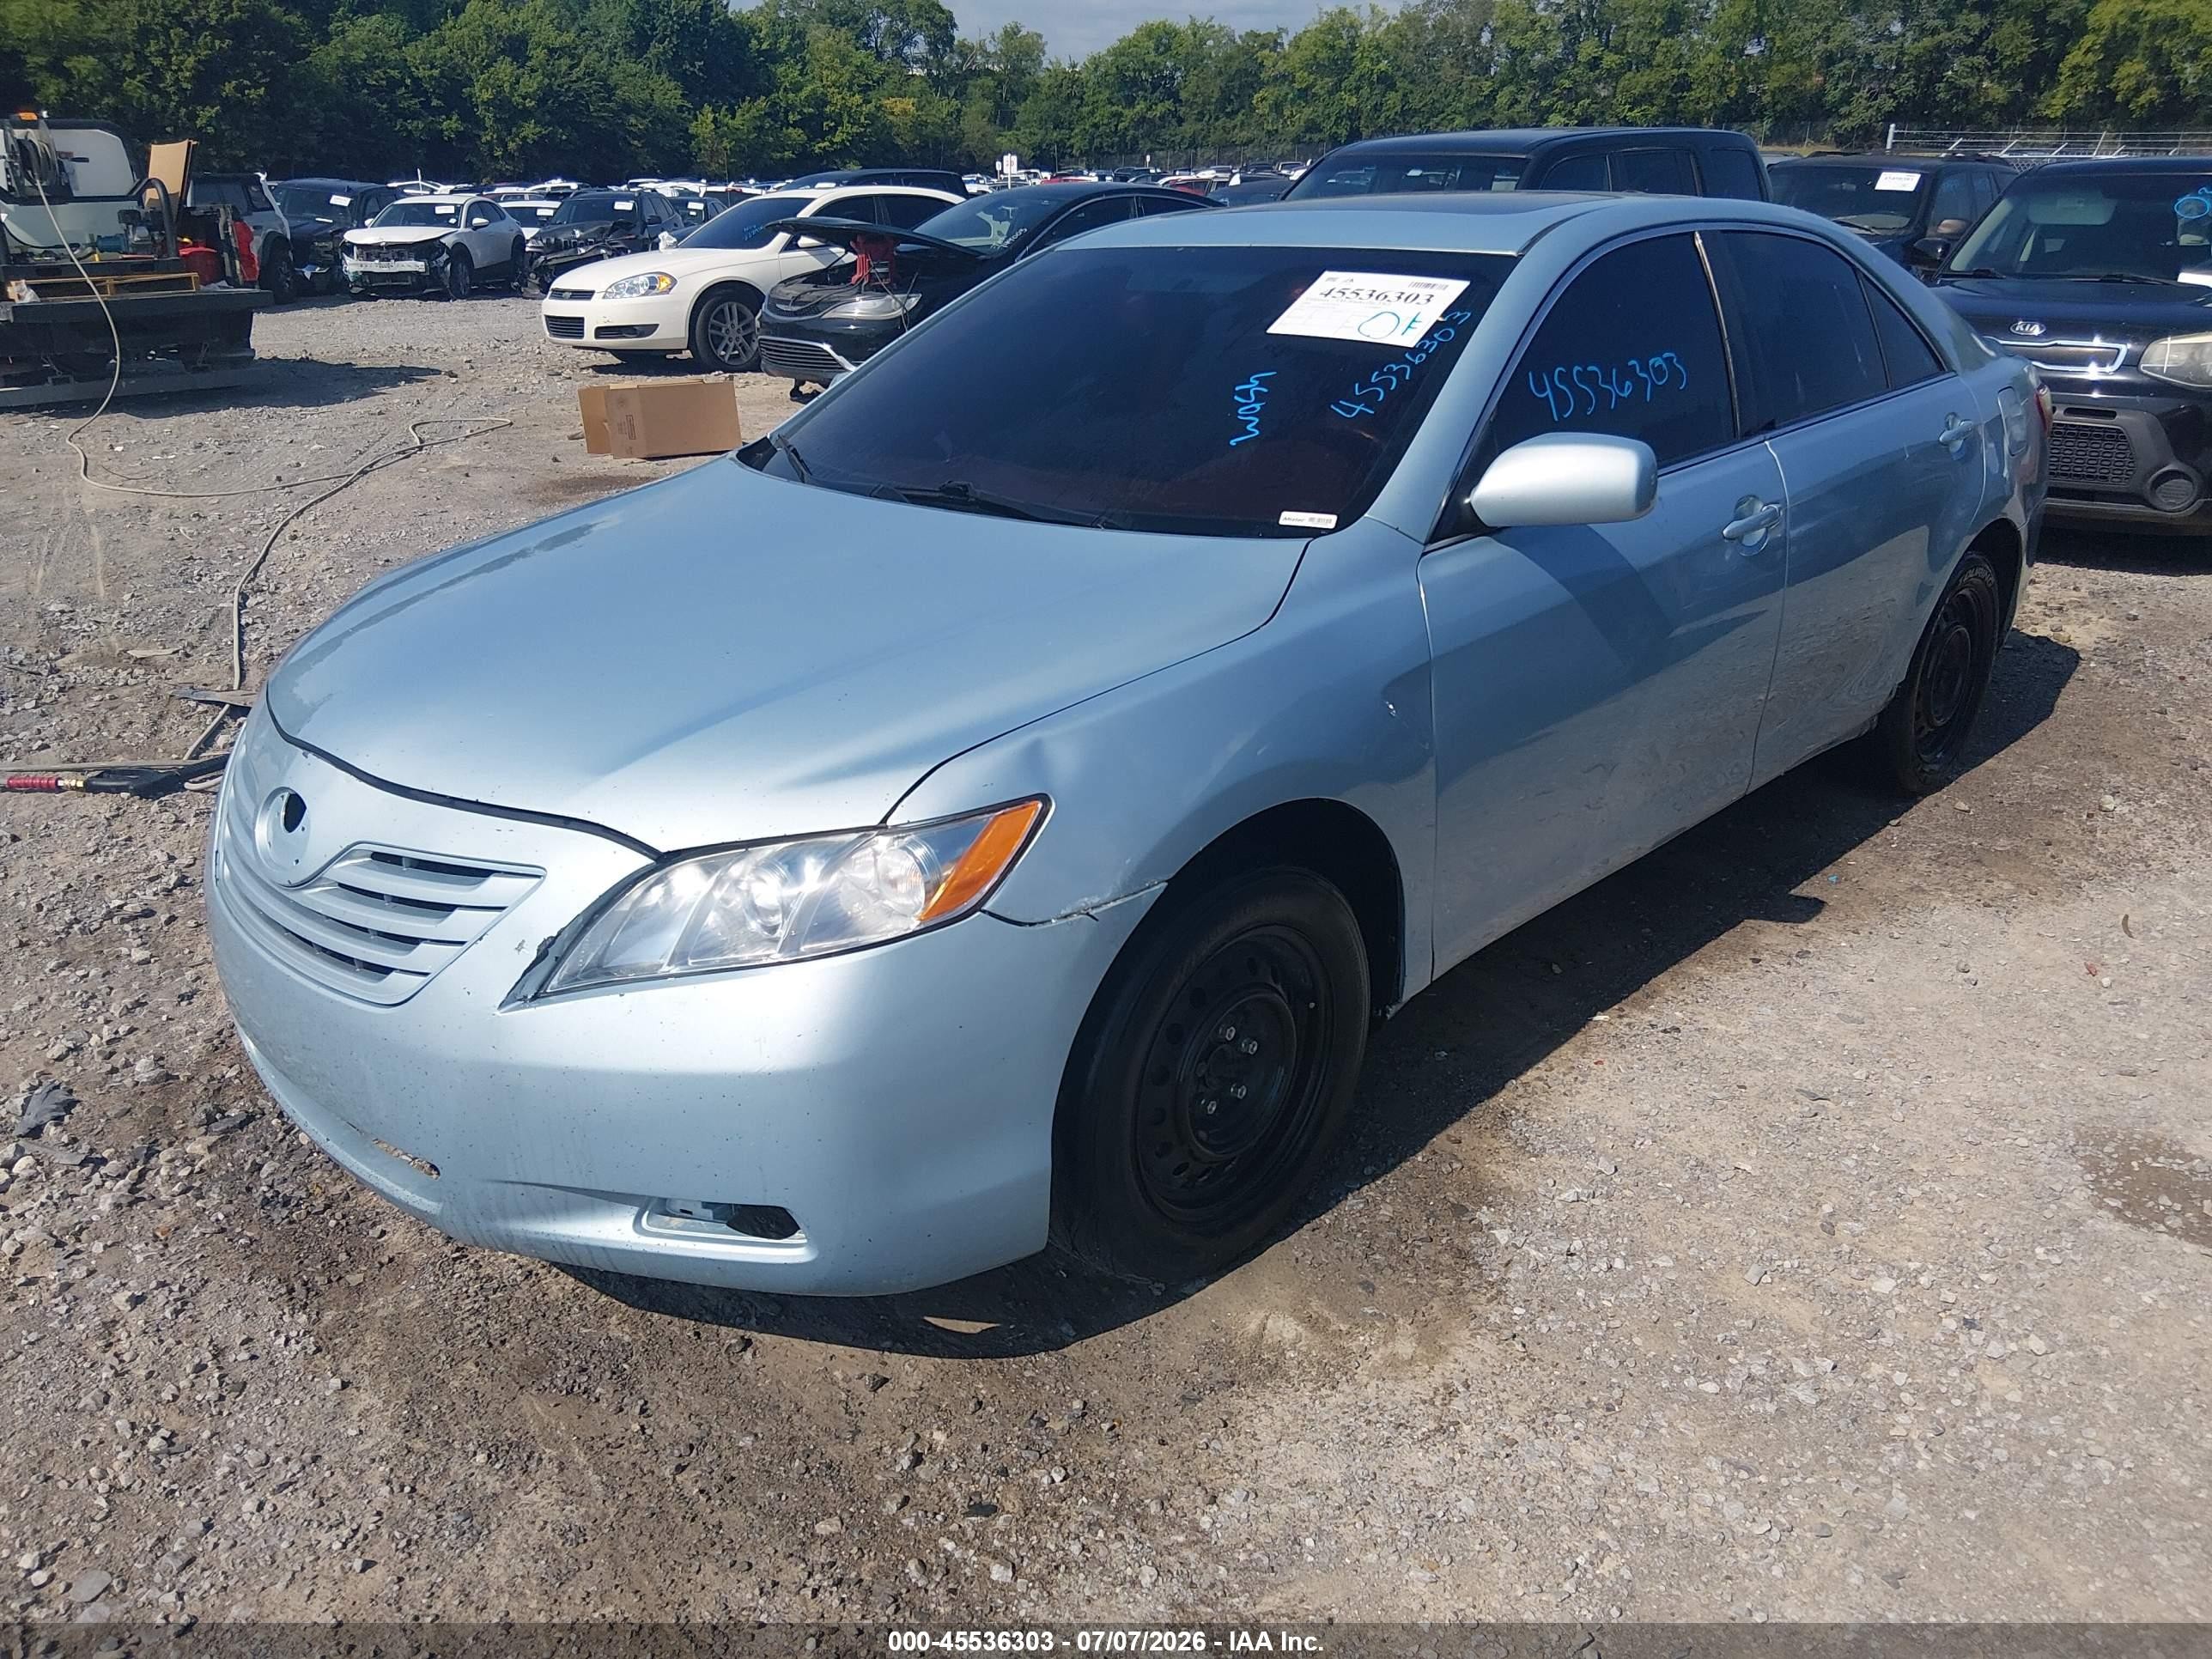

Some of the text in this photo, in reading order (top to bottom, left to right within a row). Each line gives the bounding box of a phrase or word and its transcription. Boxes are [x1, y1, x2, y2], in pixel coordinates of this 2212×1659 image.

[1319, 286, 1435, 306] 45536303
[2014, 323, 2041, 333] KIA
[1330, 310, 1472, 418] 45536303
[1528, 352, 1686, 422] 45536303
